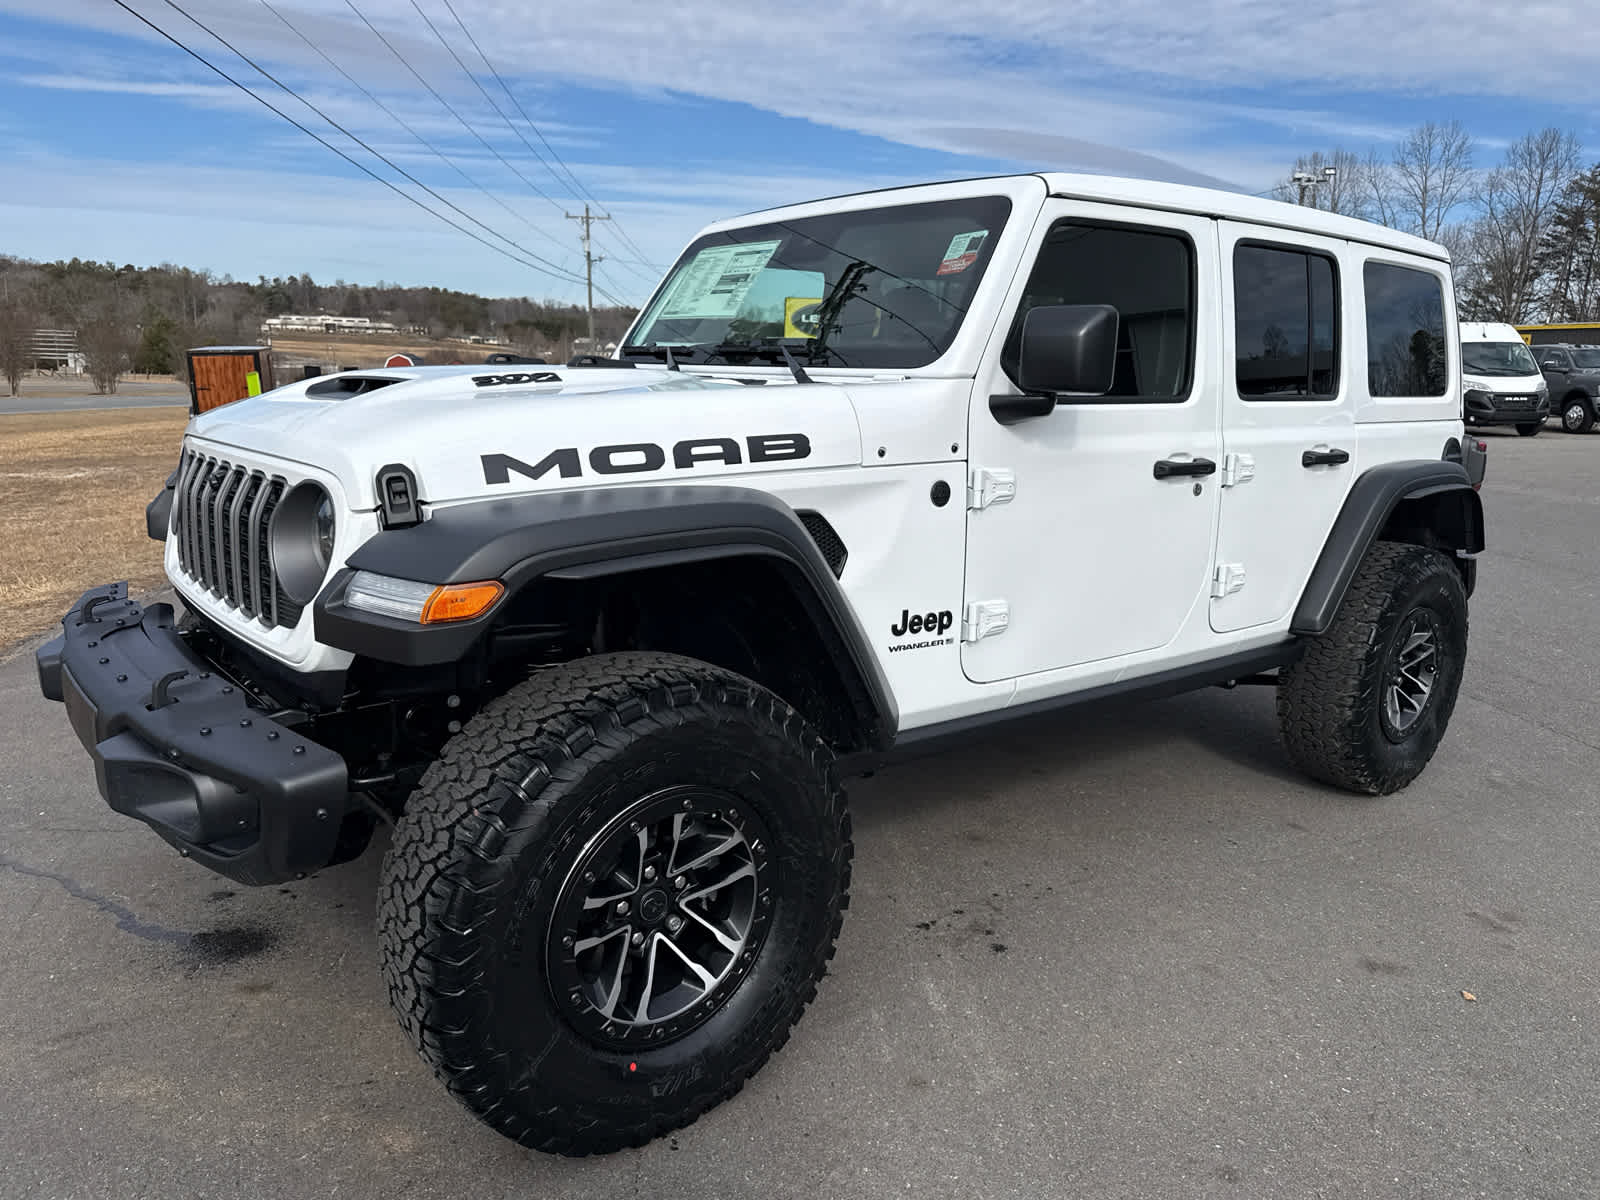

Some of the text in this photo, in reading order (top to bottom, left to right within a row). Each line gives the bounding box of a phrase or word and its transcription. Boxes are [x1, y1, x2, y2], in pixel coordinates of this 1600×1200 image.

[480, 433, 812, 485] MOAB
[891, 609, 953, 637] Jeep
[888, 639, 945, 653] WRANGLER
